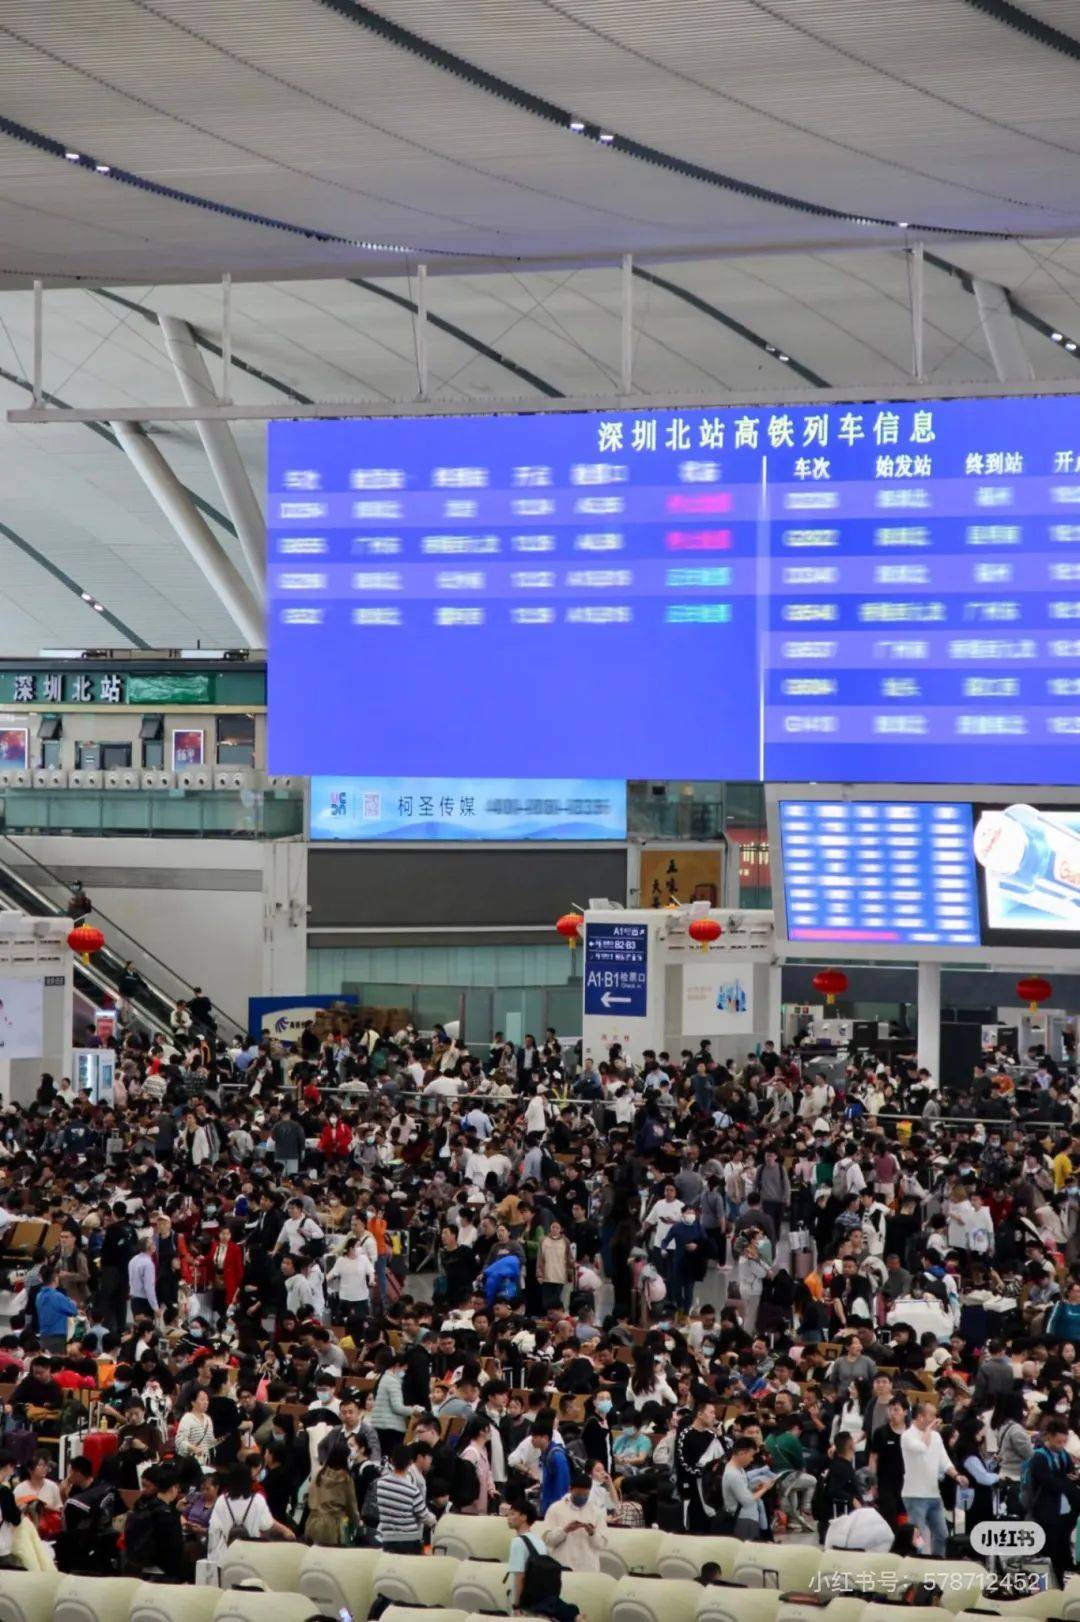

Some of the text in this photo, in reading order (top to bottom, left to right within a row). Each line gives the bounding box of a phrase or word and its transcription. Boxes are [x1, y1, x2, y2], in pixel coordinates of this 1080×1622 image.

[597, 409, 937, 453] 深圳北站高铁列车信息
[793, 450, 1080, 480] 车次 始发站 终到站 开
[13, 675, 121, 703] 深圳北站
[398, 795, 475, 817] 柯圣传媒
